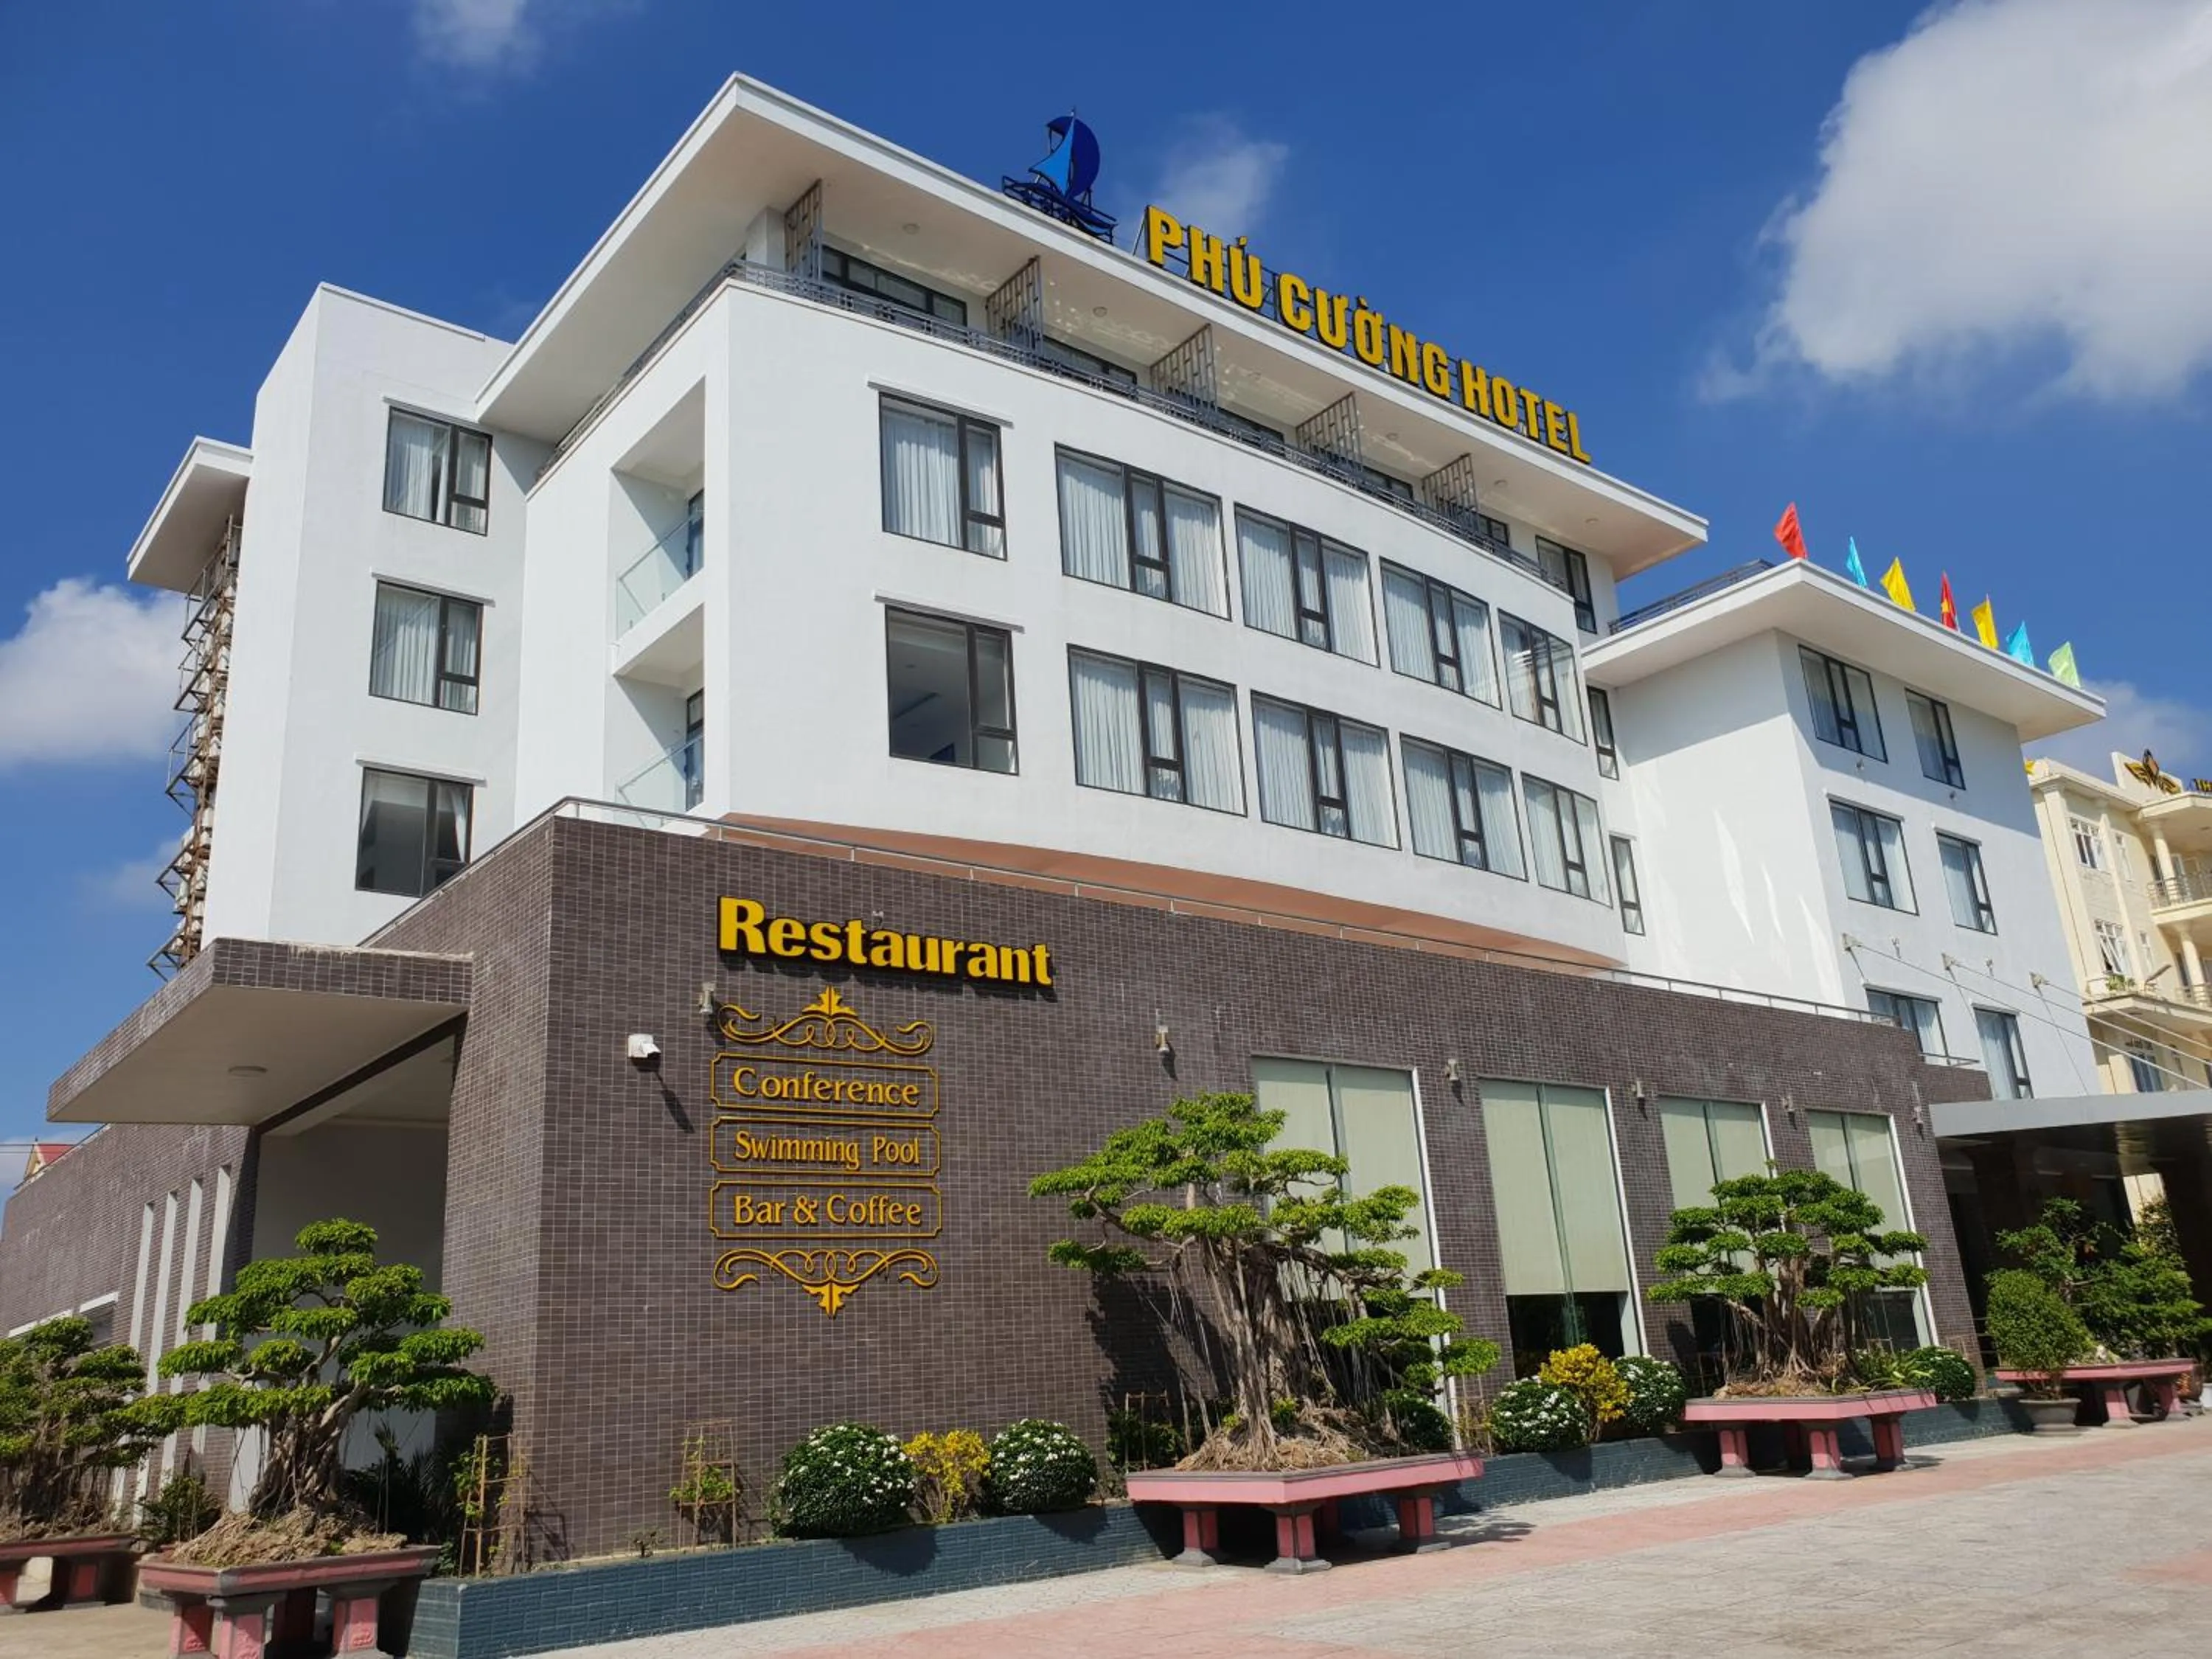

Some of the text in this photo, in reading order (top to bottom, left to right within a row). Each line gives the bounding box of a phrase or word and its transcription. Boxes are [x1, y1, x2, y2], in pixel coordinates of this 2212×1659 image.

[1146, 205, 1591, 464] PHÚ CƯỜNG HOTEL
[718, 896, 1054, 986] Restaurant
[733, 1066, 920, 1105] Conference
[734, 1130, 920, 1171] Swimming Pool
[734, 1194, 922, 1225] Bar & Coffee
